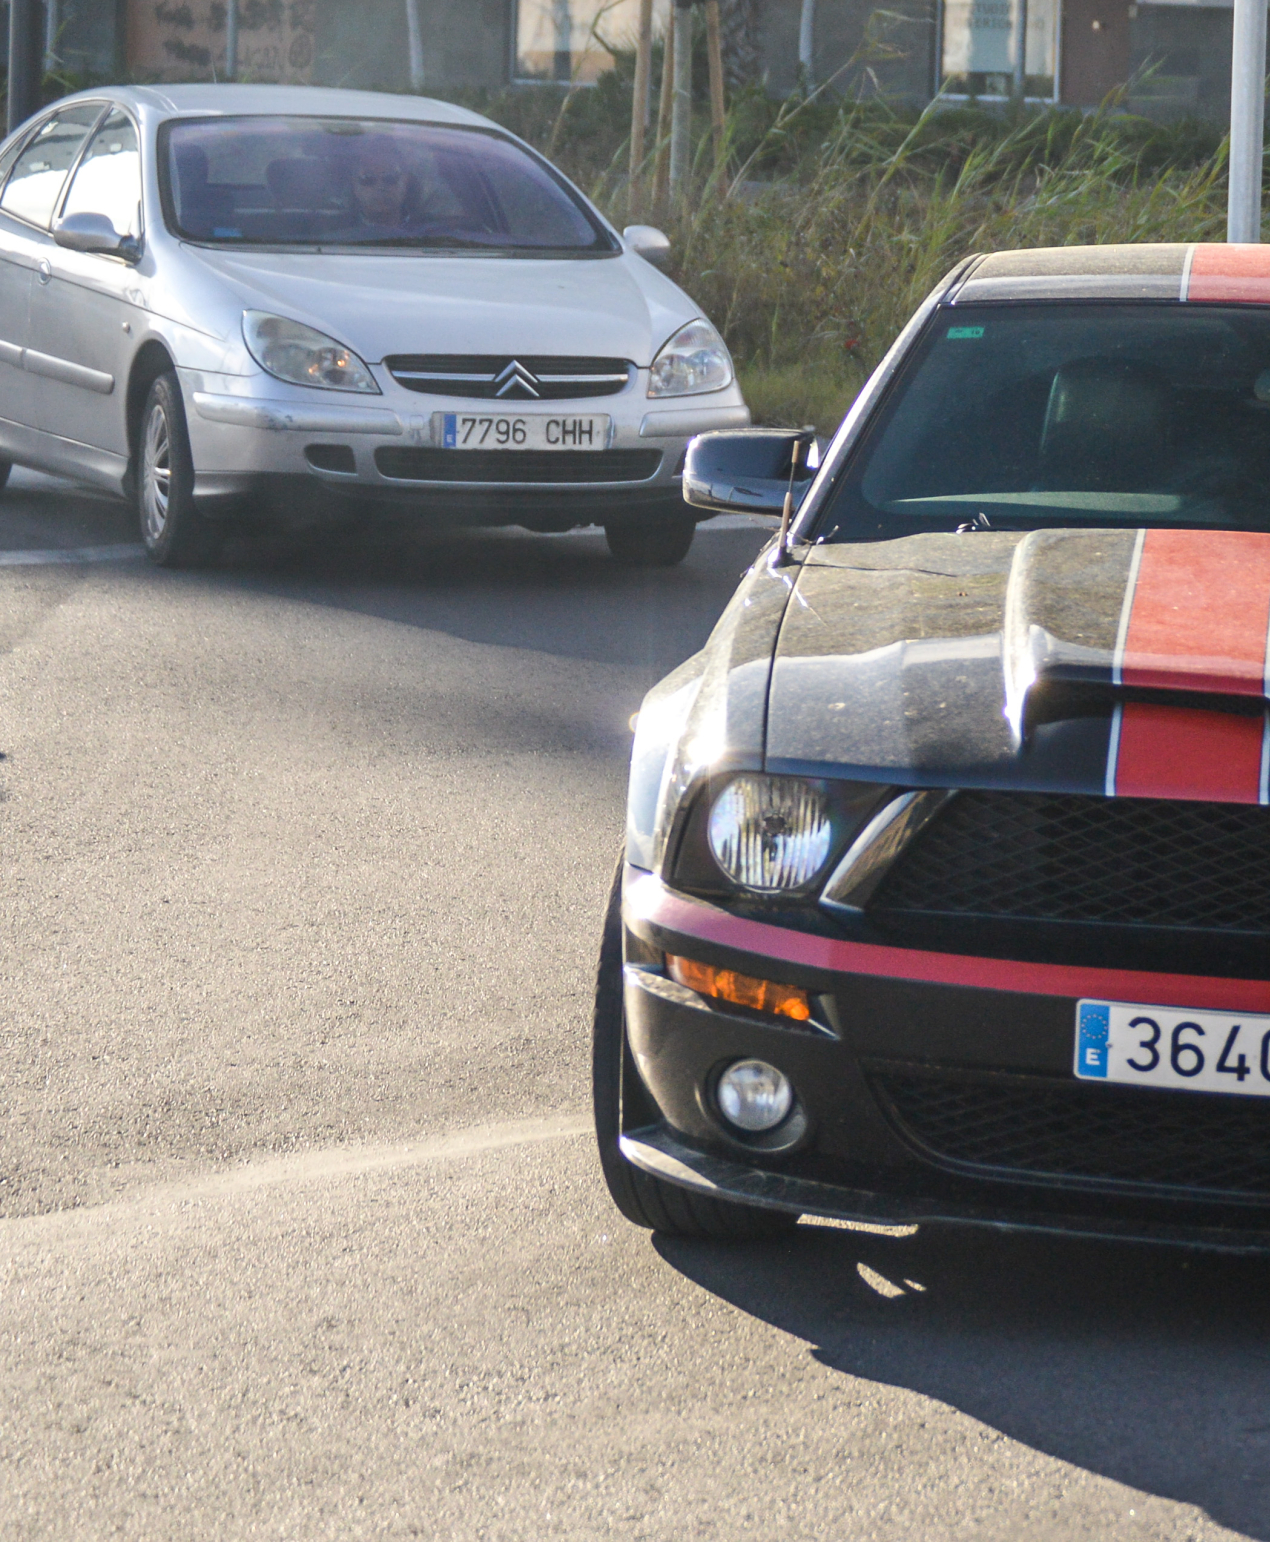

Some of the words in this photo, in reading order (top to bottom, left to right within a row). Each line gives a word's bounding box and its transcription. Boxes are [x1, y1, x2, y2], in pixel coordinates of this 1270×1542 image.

[461, 418, 527, 445] 7796
[545, 418, 594, 446] CHH
[1086, 1048, 1101, 1066] E
